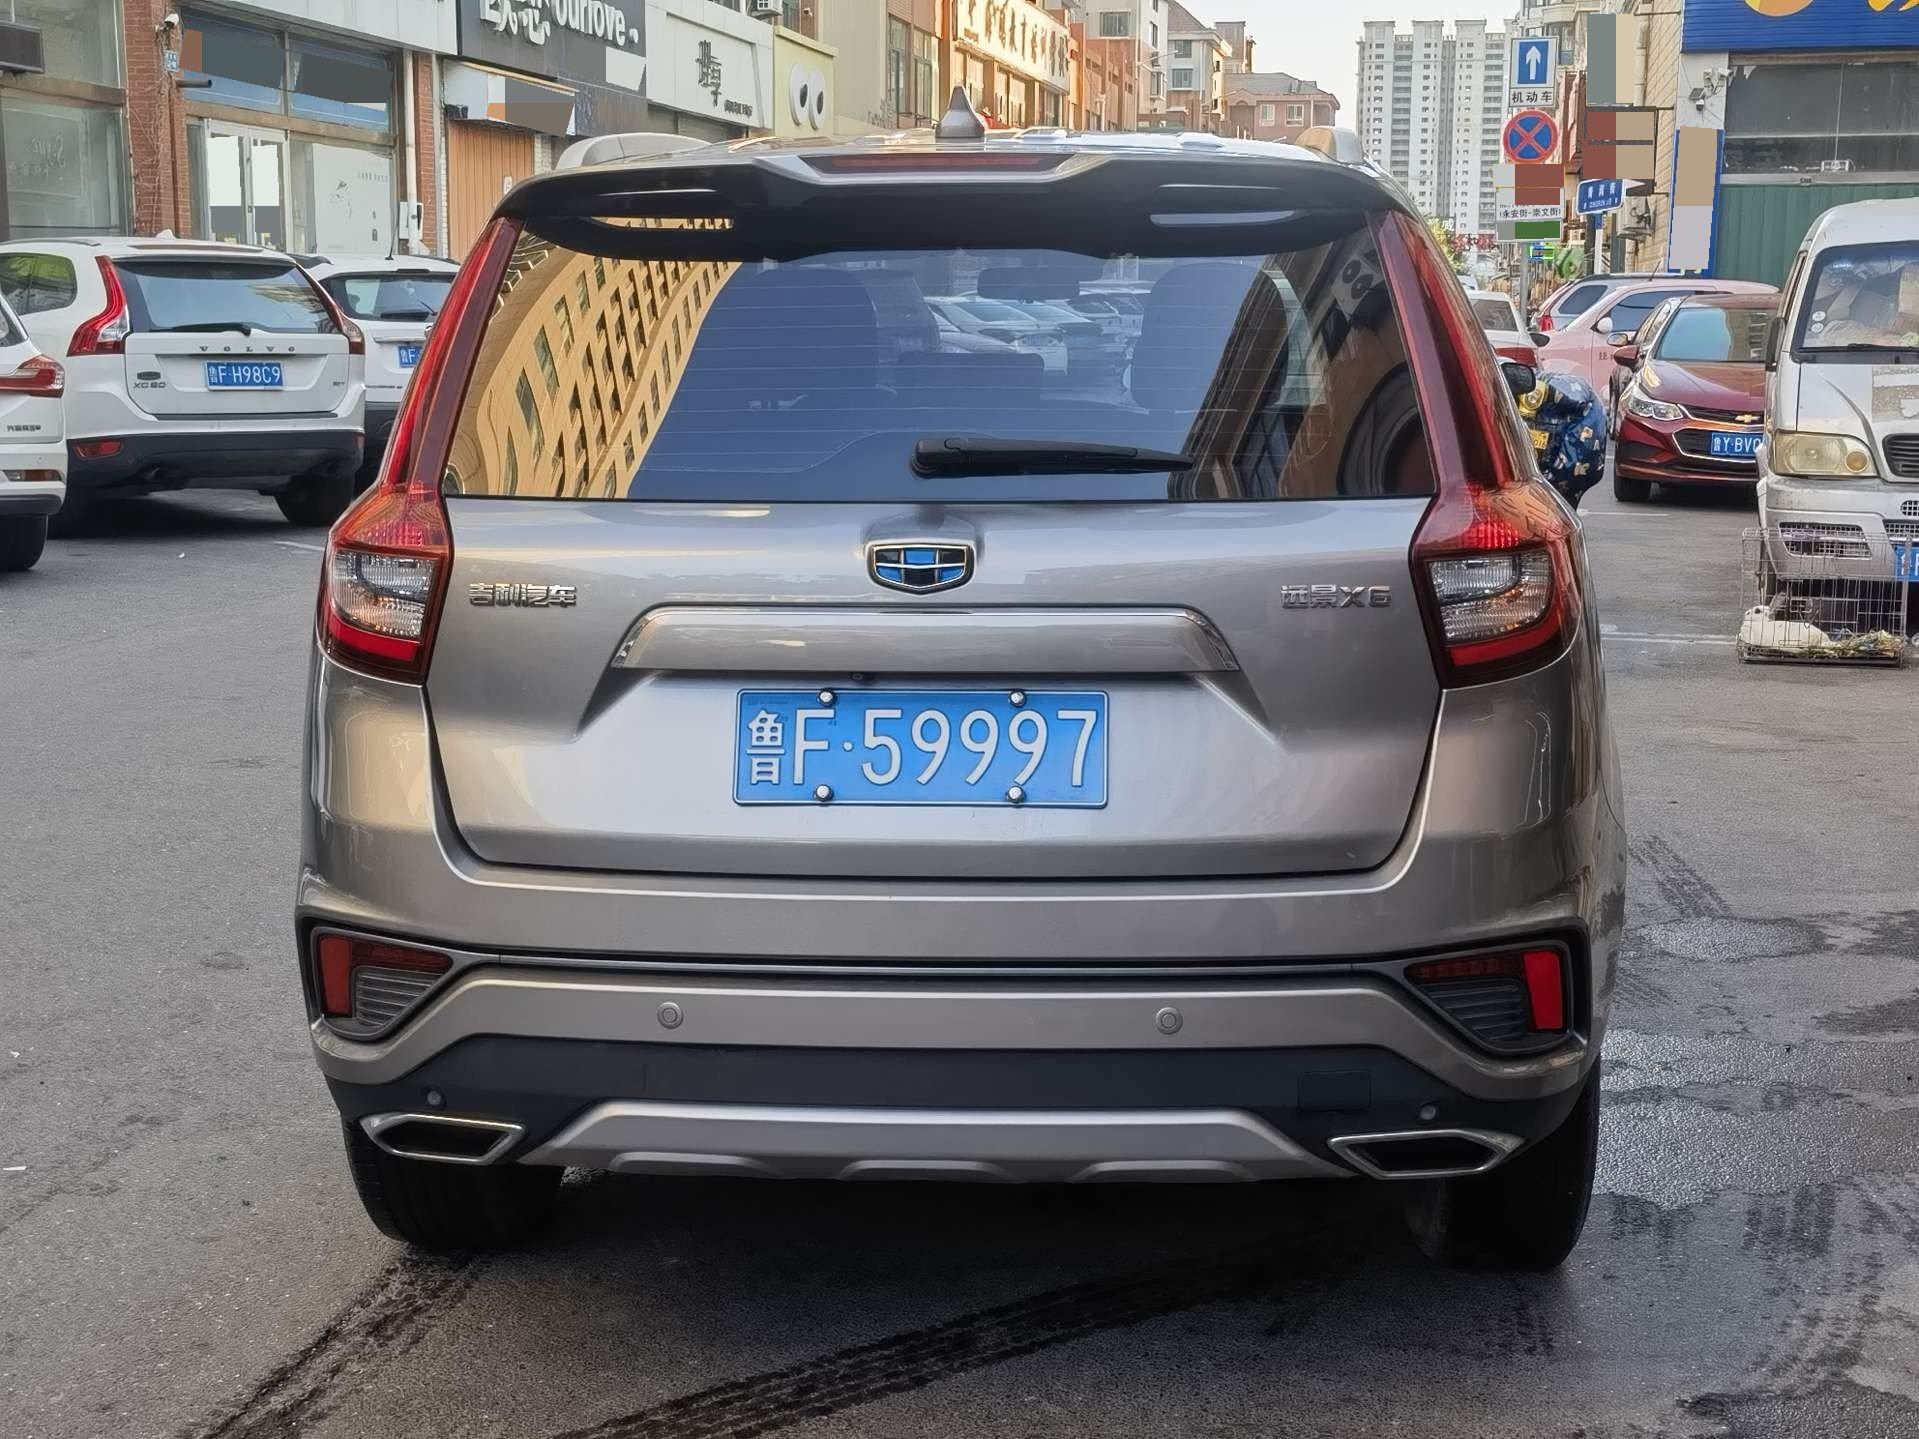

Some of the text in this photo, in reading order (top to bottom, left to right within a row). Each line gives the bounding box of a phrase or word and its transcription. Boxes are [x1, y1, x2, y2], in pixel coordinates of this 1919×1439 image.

[1512, 91, 1553, 103] 机动车
[200, 345, 295, 353] VOLVO
[469, 582, 577, 608] 吉利汽车
